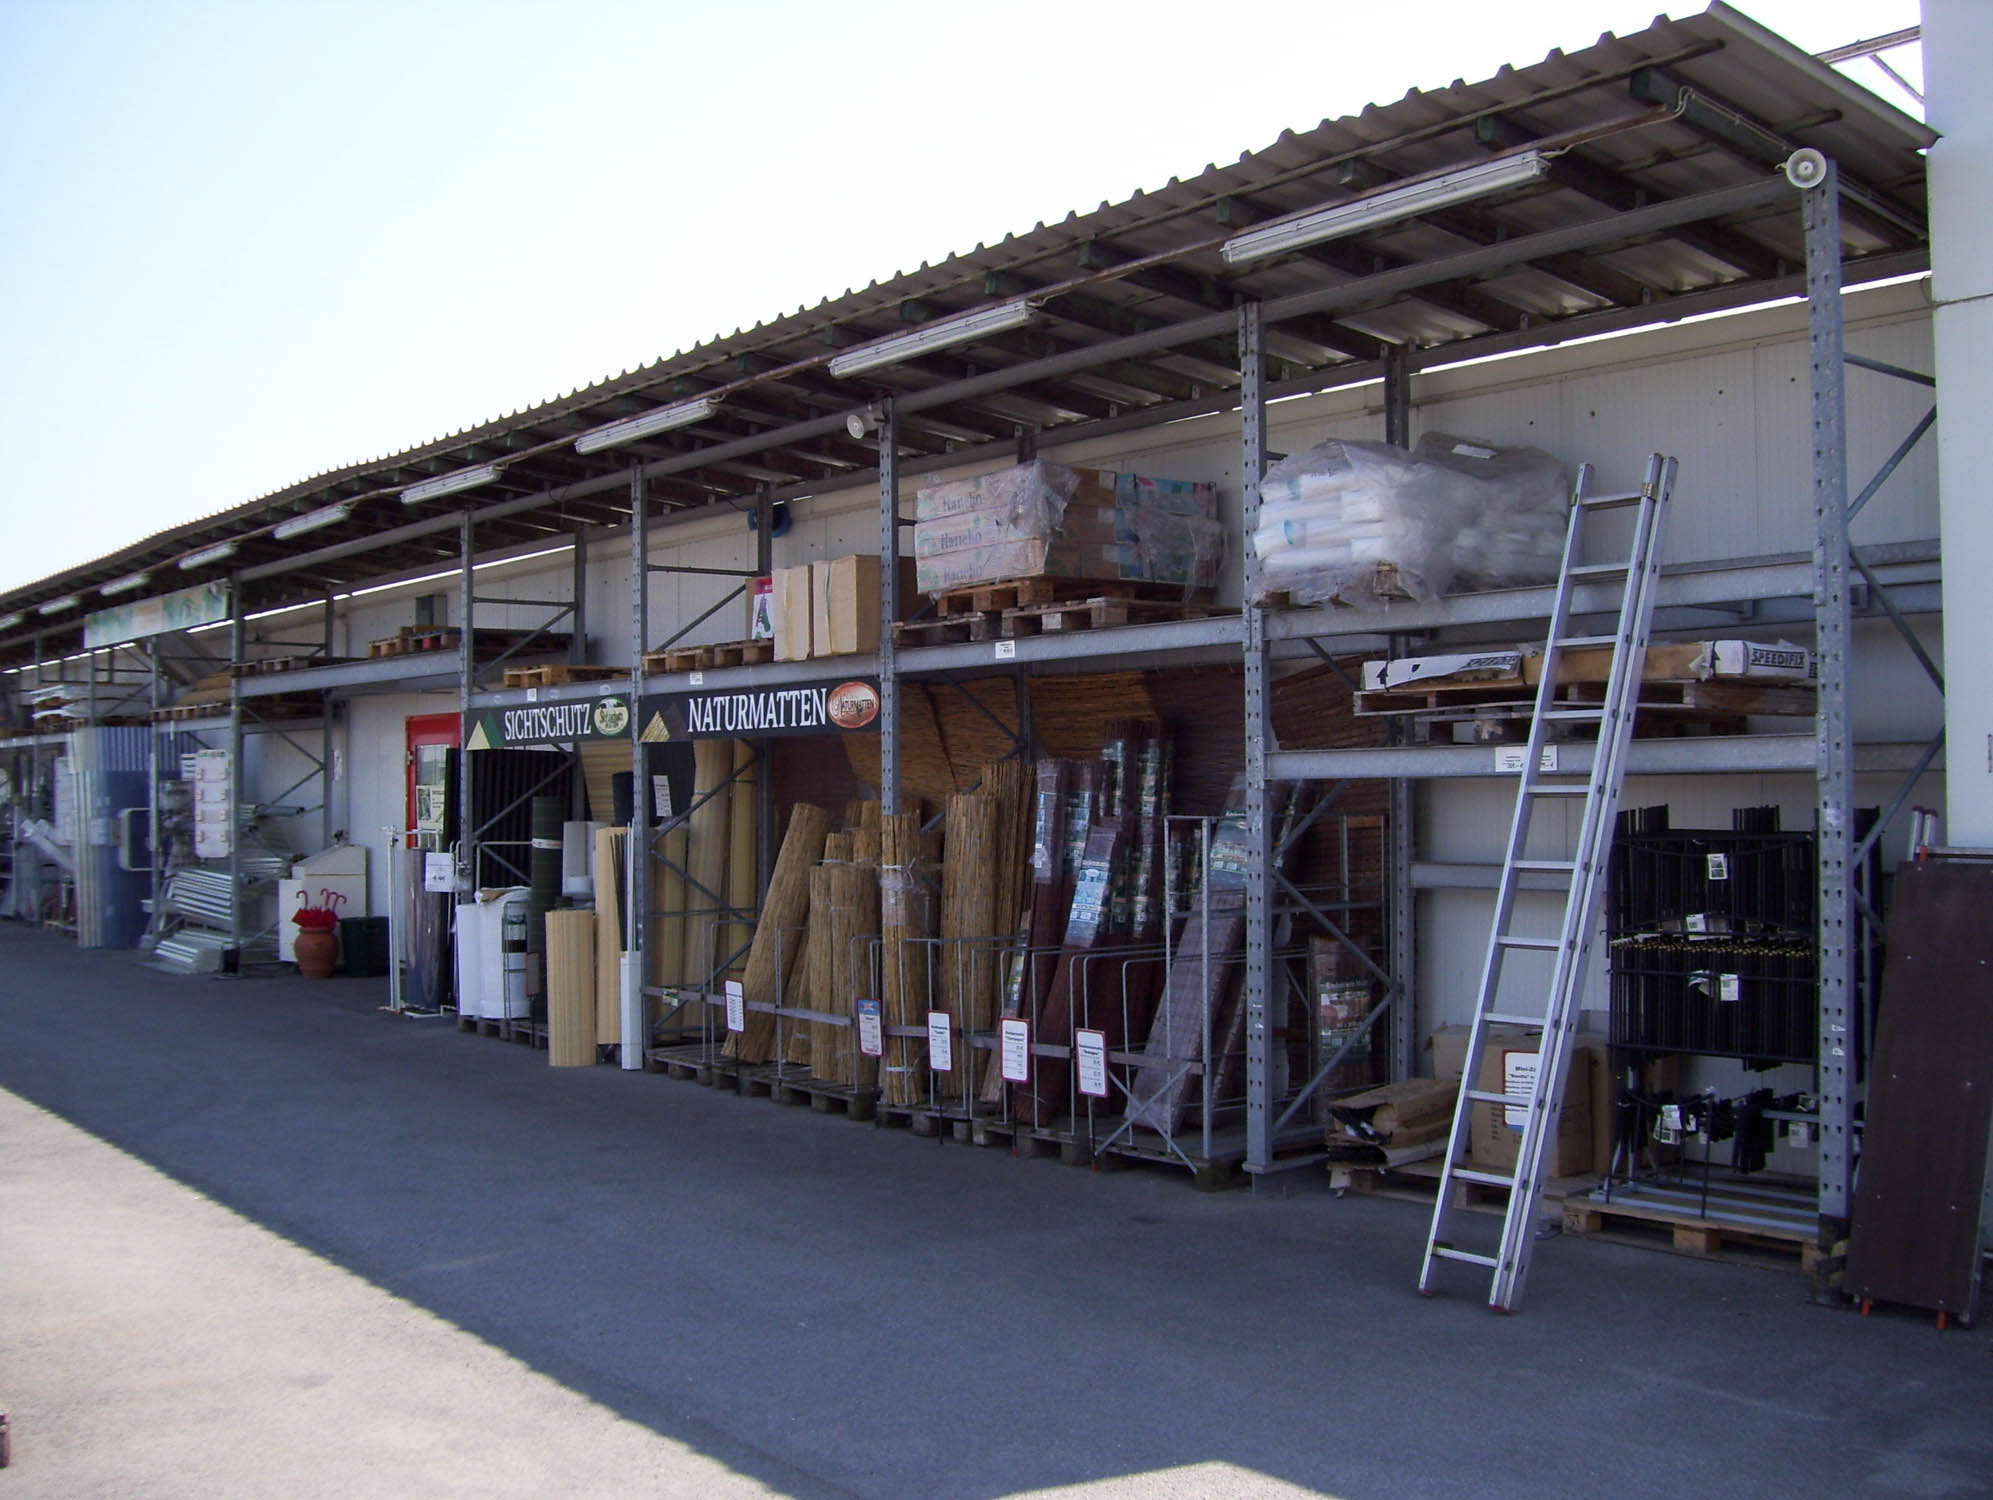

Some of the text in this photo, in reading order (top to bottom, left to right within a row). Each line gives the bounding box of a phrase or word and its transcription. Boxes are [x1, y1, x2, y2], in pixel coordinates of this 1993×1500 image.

[1751, 650, 1805, 666] SPEEDIFIX
[505, 704, 592, 742] SICHTSCHUTZ
[688, 689, 827, 733] NATURMATTEN
